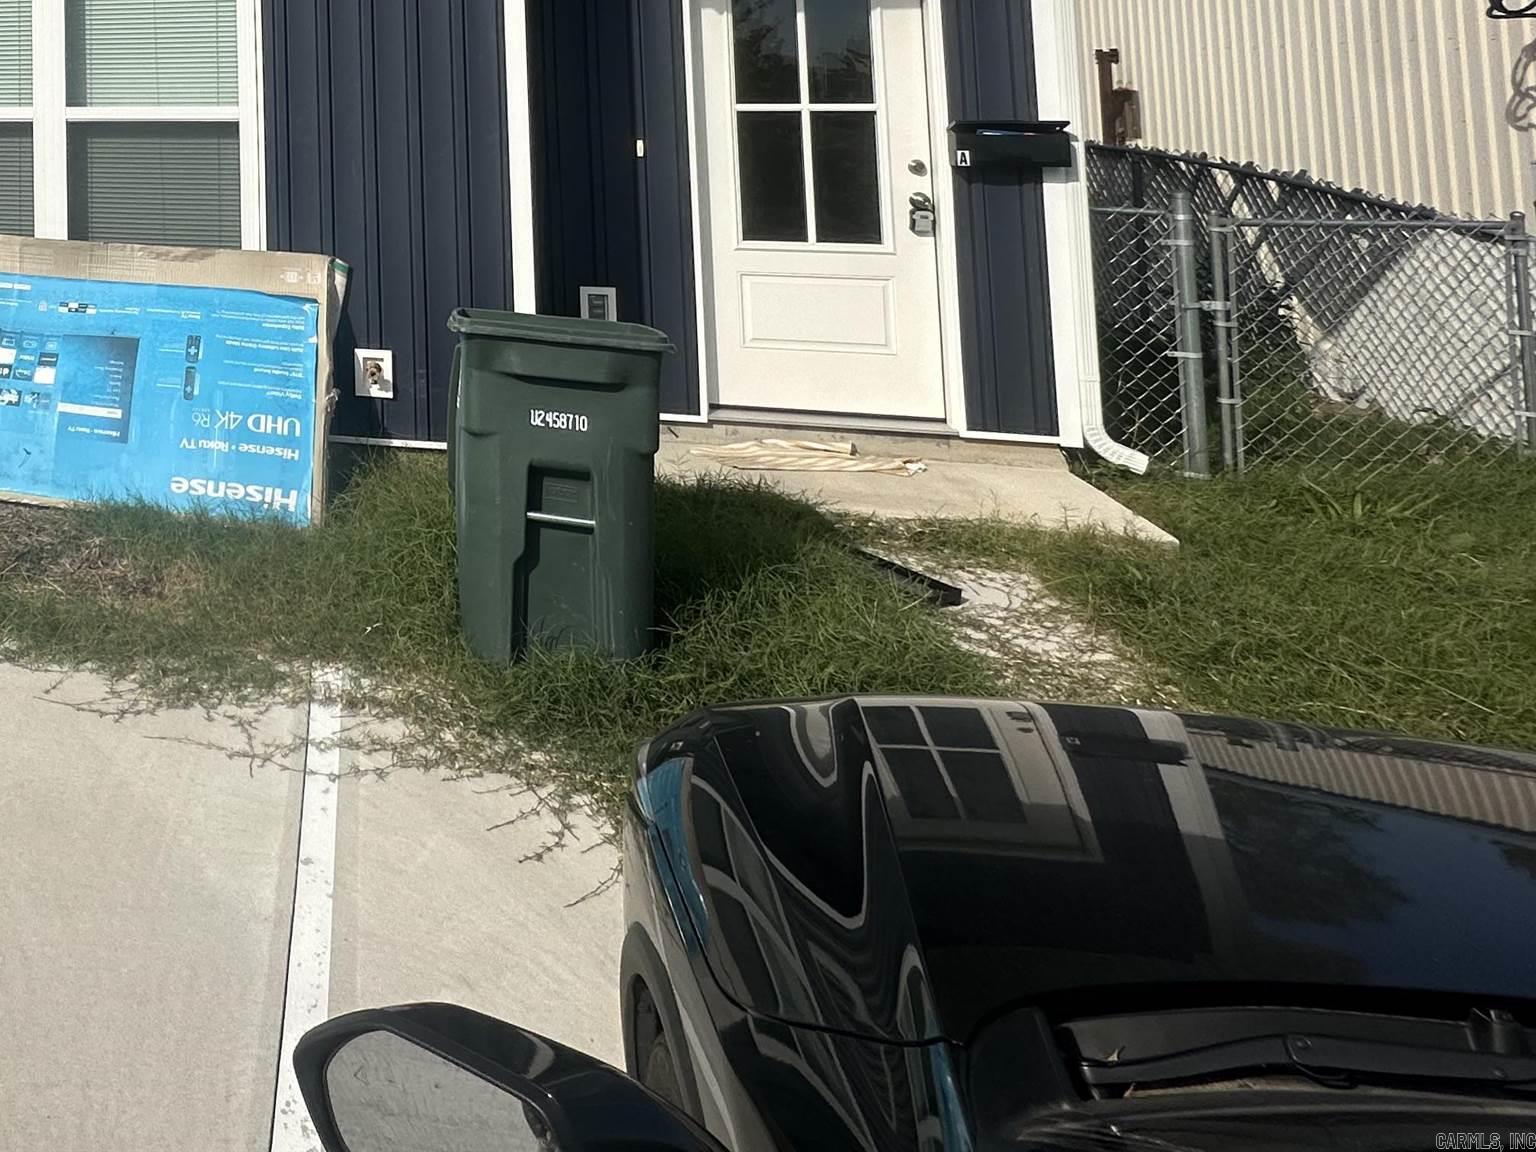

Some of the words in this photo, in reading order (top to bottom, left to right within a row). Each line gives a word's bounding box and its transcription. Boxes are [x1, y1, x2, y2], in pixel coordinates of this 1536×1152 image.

[192, 412, 211, 428] R6
[213, 409, 244, 429] 4K
[246, 413, 302, 437] UHD
[530, 409, 588, 432] U2458710
[180, 437, 196, 449] TV
[199, 440, 230, 453] Roku
[239, 442, 300, 460] Hisense
[169, 476, 298, 513] Hisense
